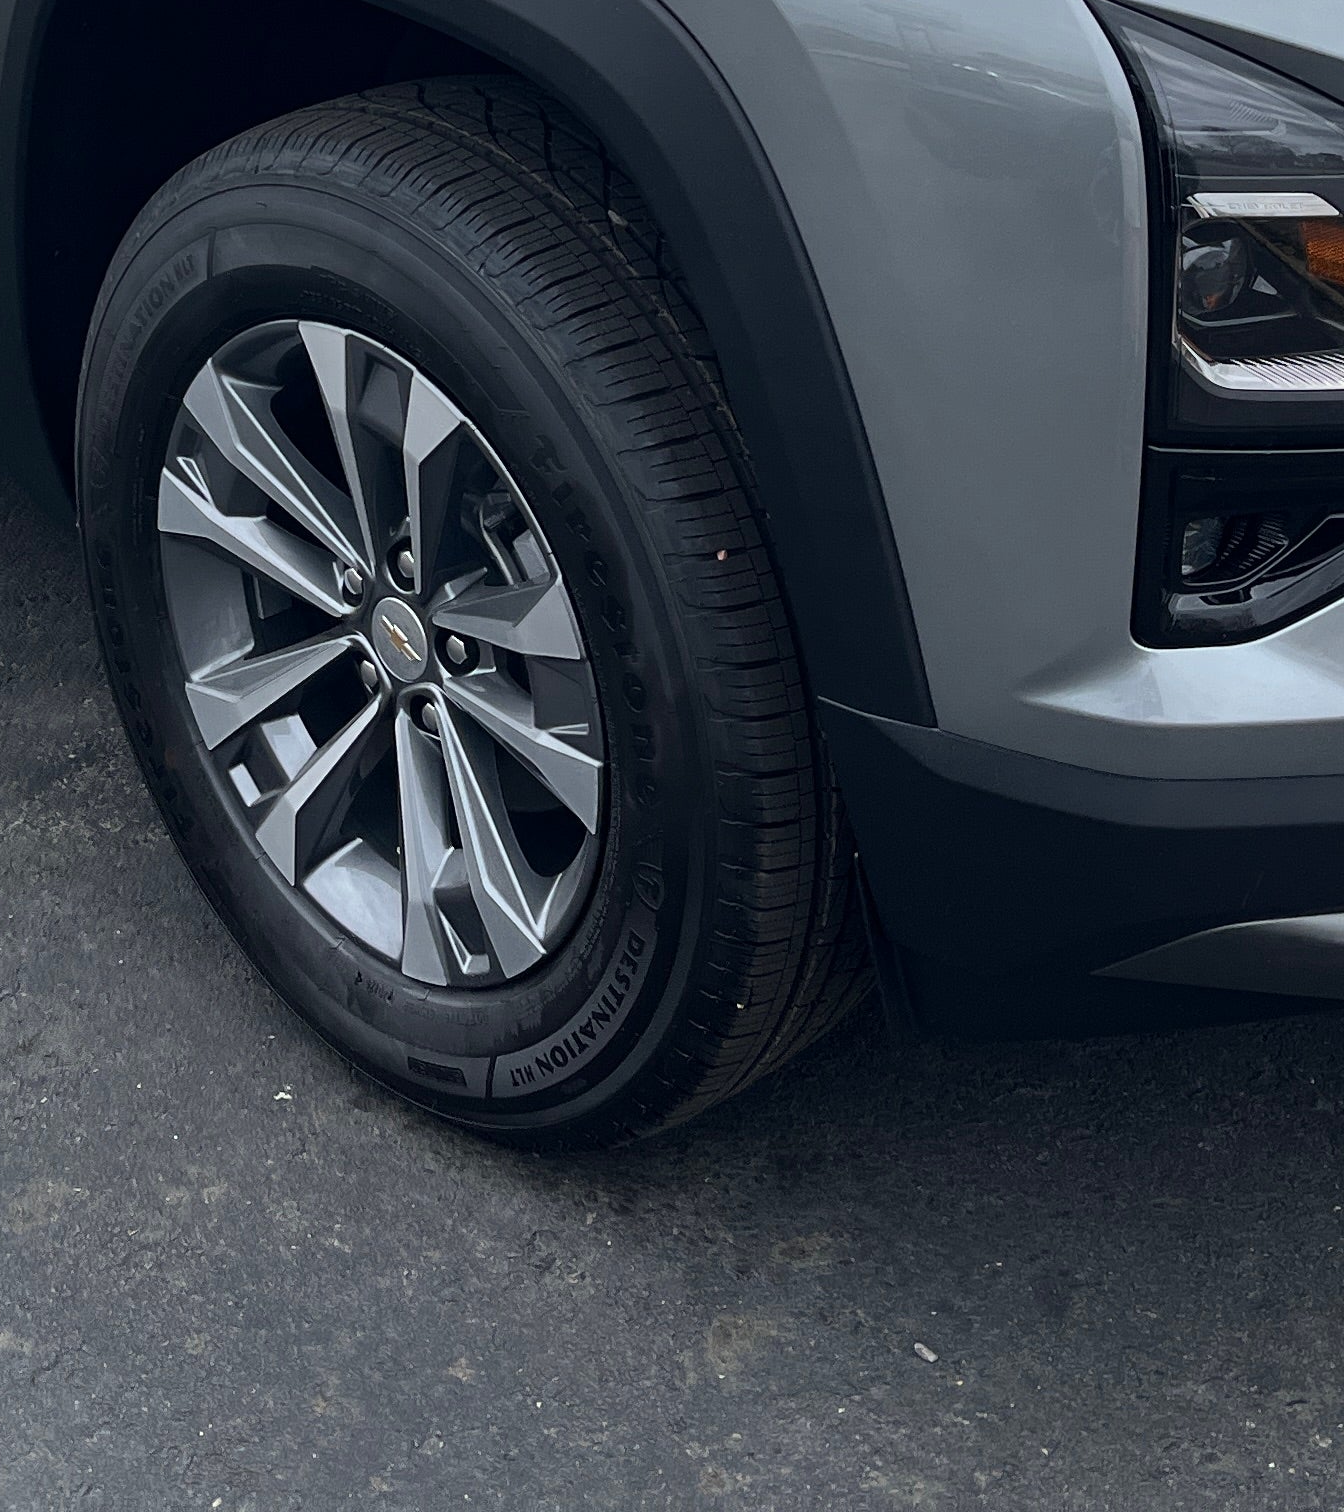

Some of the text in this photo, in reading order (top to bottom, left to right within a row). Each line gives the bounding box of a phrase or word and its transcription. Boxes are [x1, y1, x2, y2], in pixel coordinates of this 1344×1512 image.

[1227, 201, 1304, 210] CHEVROLET
[509, 928, 646, 1088] DESTINATION HLT
